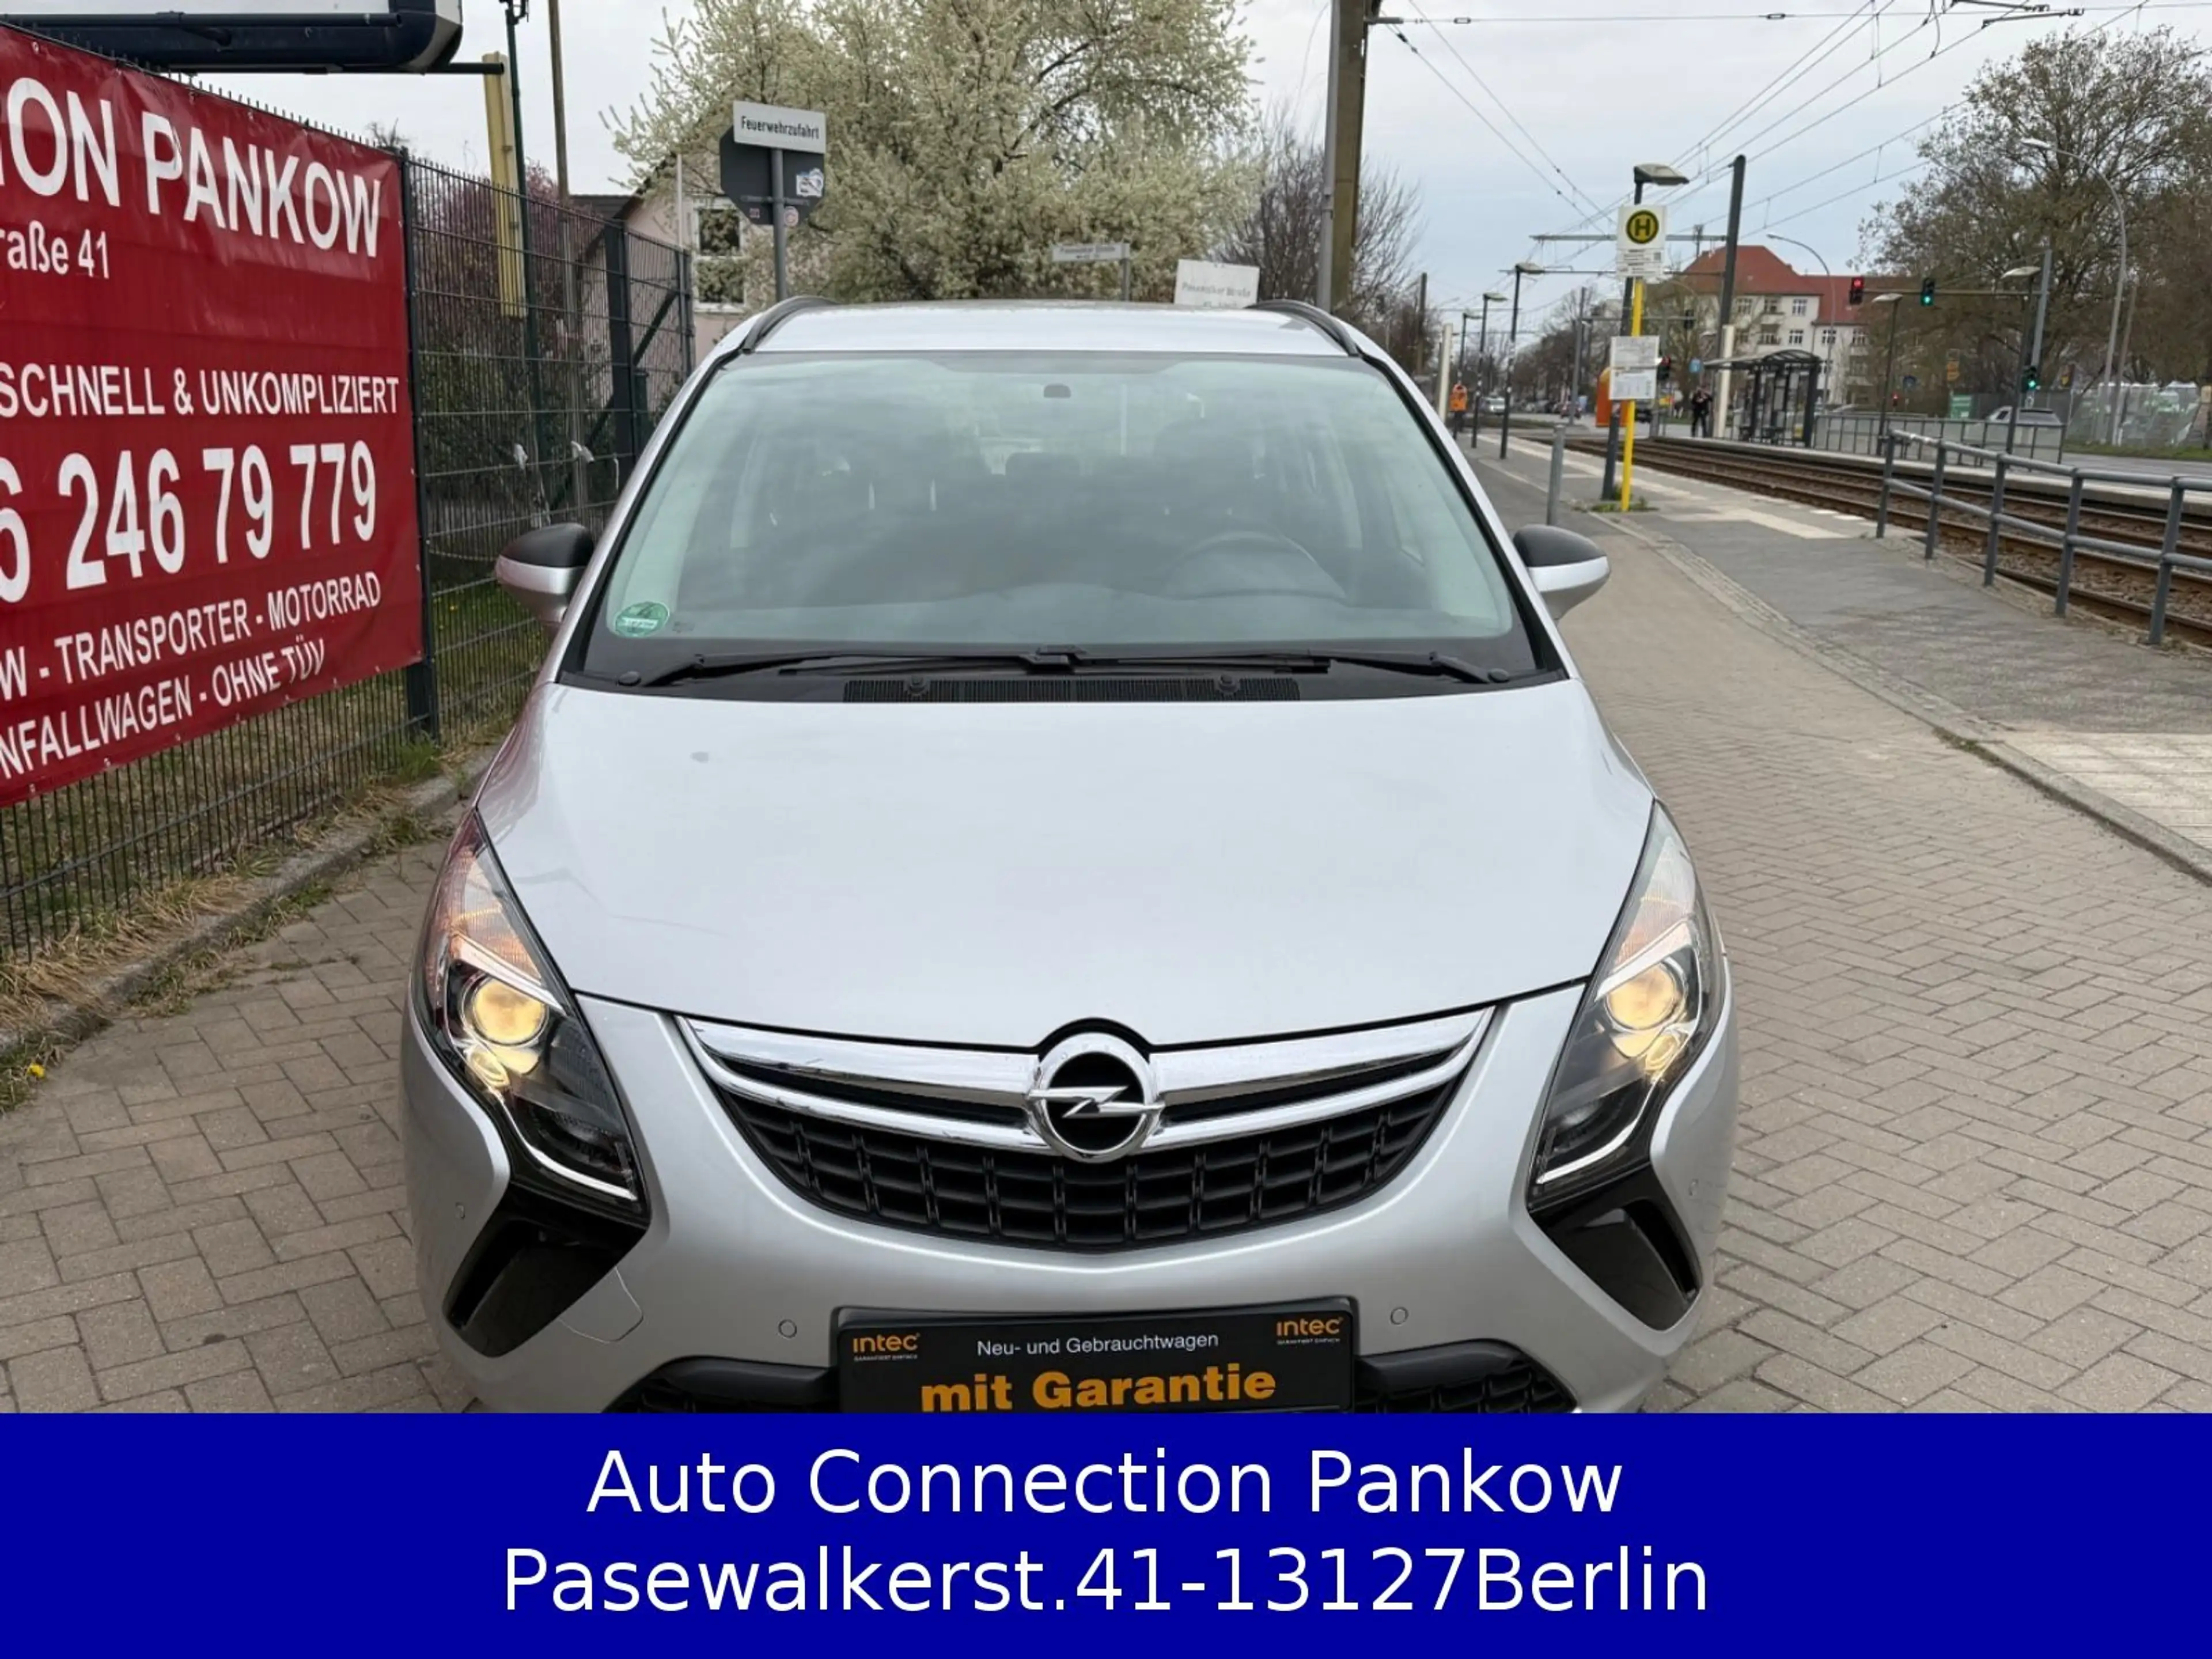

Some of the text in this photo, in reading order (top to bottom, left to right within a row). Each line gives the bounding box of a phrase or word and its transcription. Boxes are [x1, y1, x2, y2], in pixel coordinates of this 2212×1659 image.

[740, 115, 820, 140] Feuerwehrzufahrt
[142, 111, 381, 258] PANKOW
[78, 229, 109, 279] 41
[0, 362, 399, 418] SCHNELL & UNKOMPLIZIERT
[58, 448, 185, 590] 246
[202, 444, 273, 565] 79
[289, 440, 376, 550] 779
[54, 598, 252, 684] TRANSPORTER
[267, 571, 381, 631] MOTORRAD
[0, 675, 192, 779] NFALLWAGEN
[212, 652, 281, 707] OHNE
[281, 634, 325, 684] TÜV
[977, 1334, 1219, 1356] Neu- und Gebrauchtwagen
[922, 1362, 1275, 1412] mit Garantie
